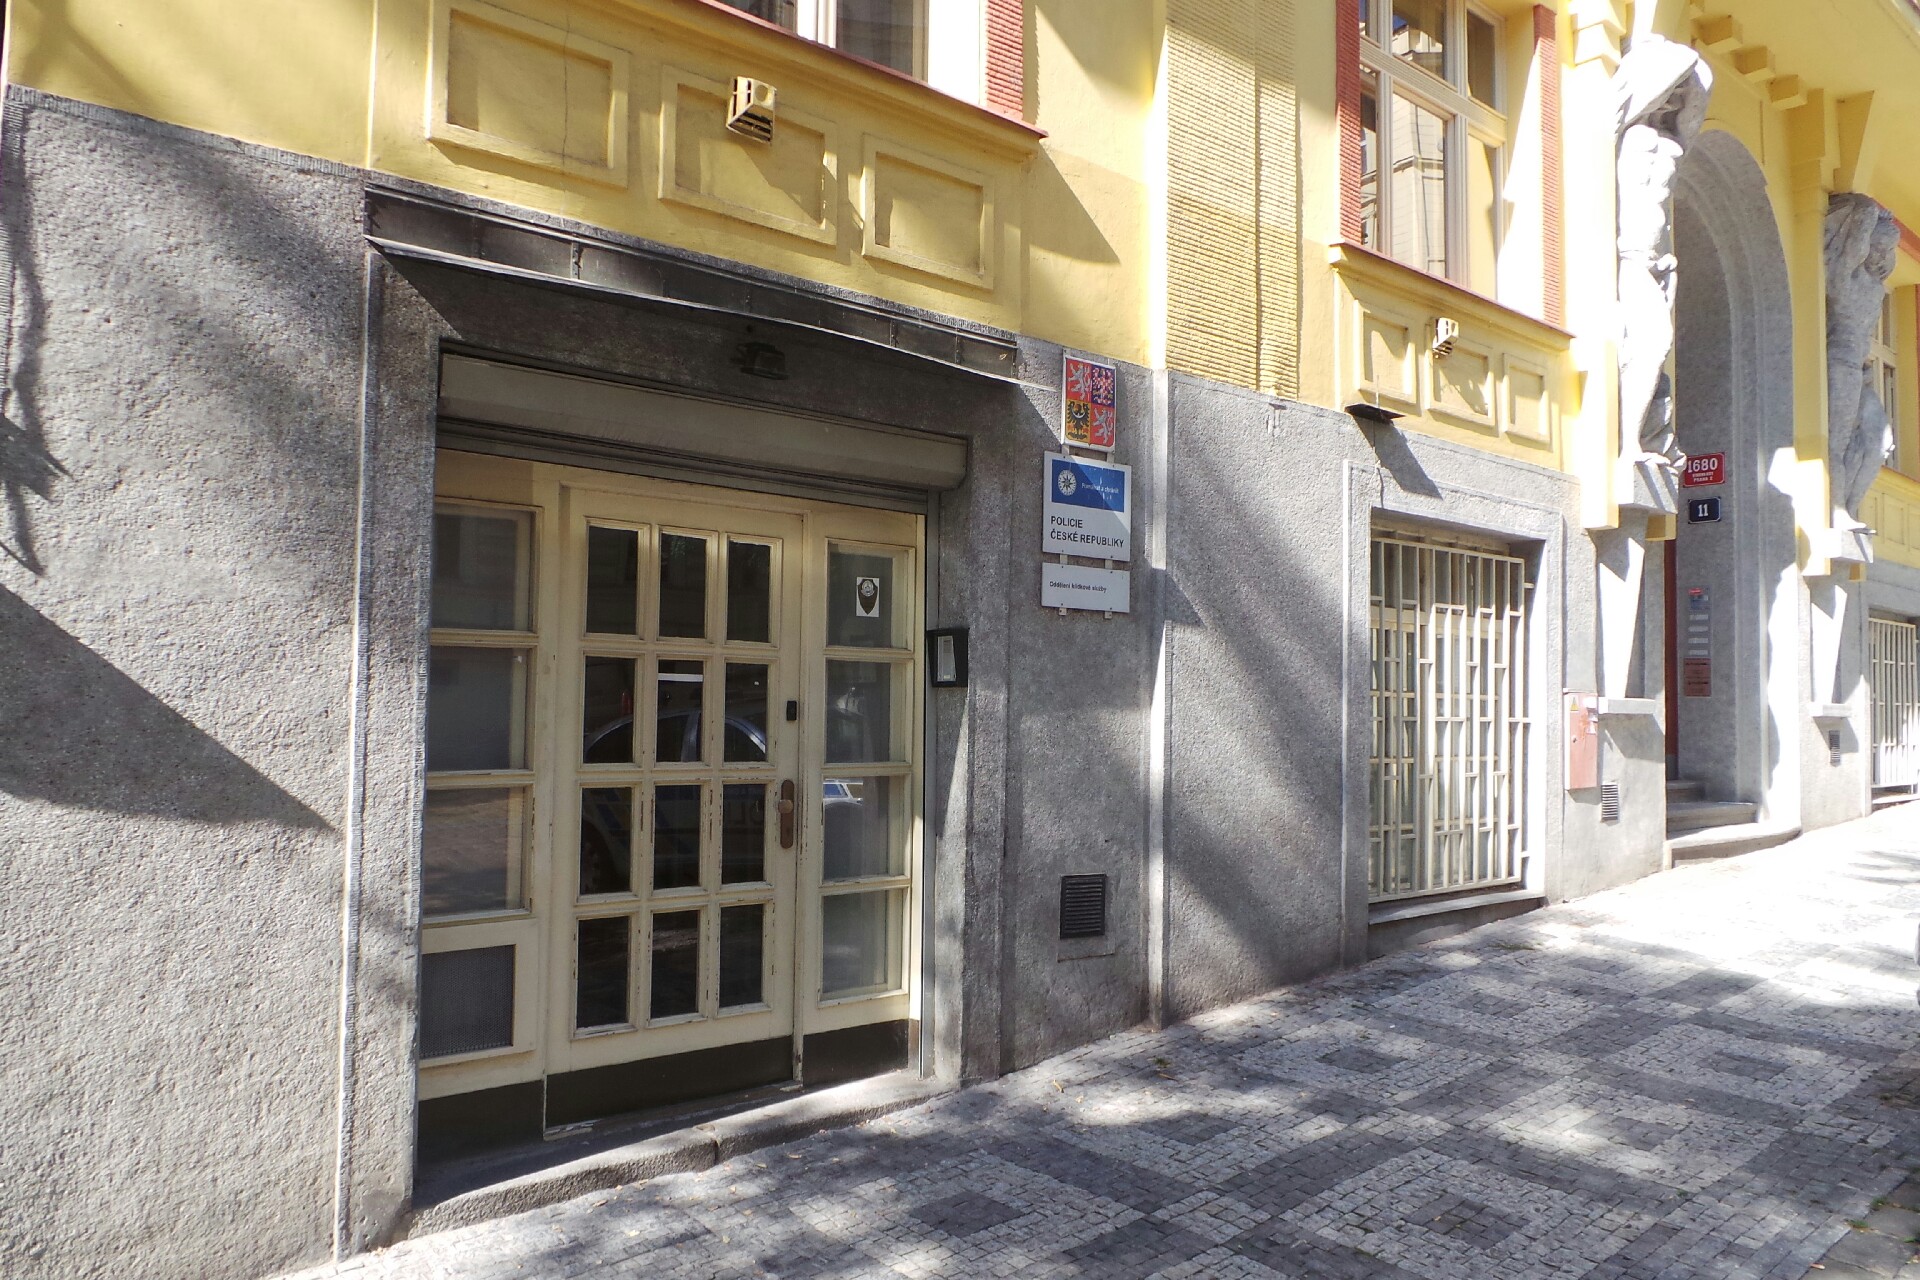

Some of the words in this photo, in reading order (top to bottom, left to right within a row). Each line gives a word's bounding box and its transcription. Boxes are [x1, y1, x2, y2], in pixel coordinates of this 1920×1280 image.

[1688, 458, 1718, 473] 1680
[1698, 503, 1708, 517] 11
[1051, 515, 1083, 528] POLICIE
[1050, 528, 1079, 542] ČESKÉ
[1080, 534, 1124, 548] REPUBLIKY
